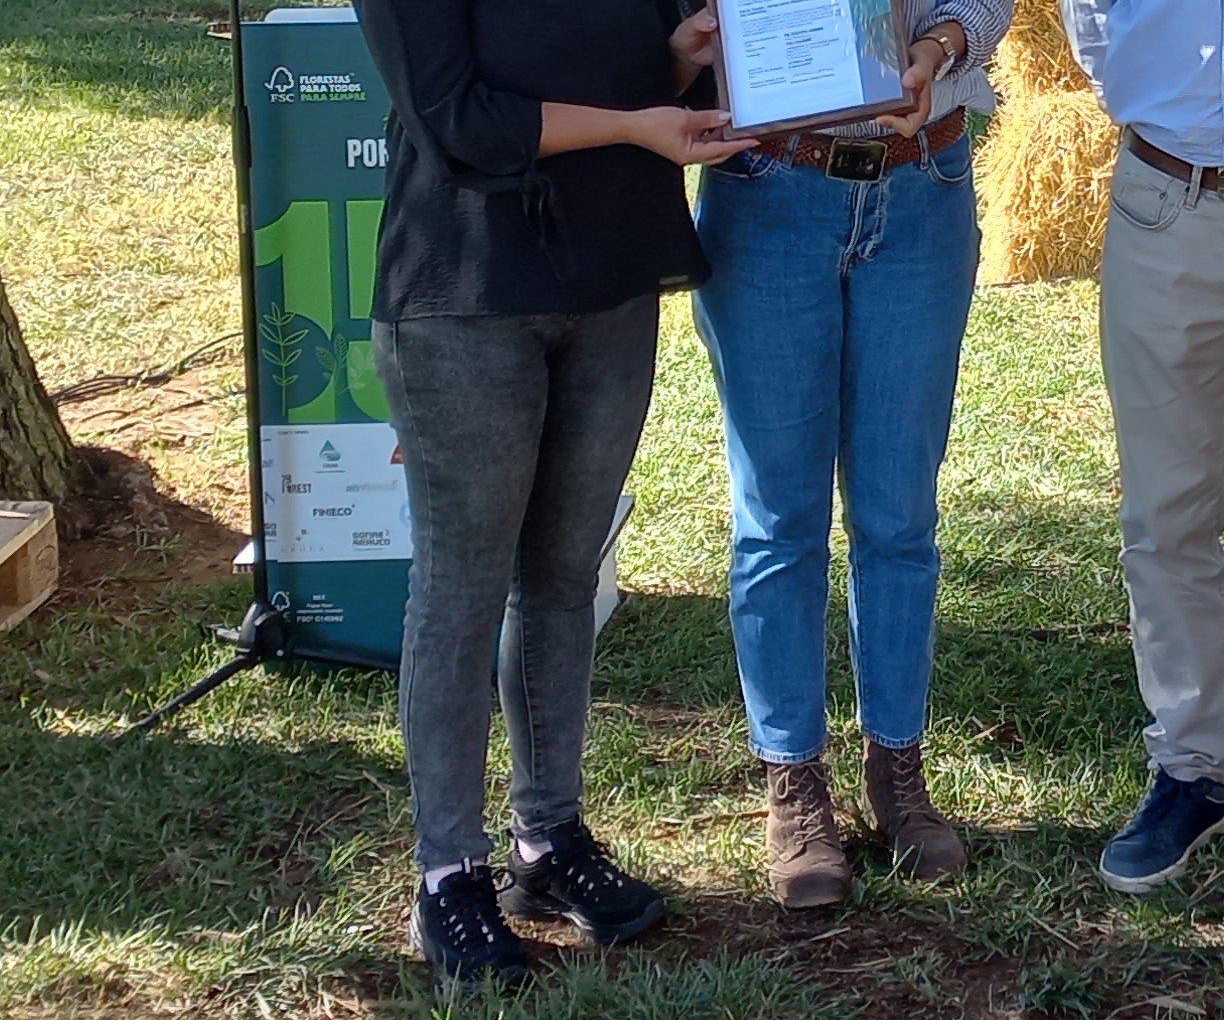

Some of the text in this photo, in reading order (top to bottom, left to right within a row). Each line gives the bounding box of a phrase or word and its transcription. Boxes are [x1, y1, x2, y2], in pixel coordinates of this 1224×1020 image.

[300, 75, 351, 85] FLORESTAS
[300, 83, 361, 92] PARA TODOS
[270, 93, 295, 103] FSC
[300, 93, 329, 101] PARA
[346, 138, 389, 168] POR
